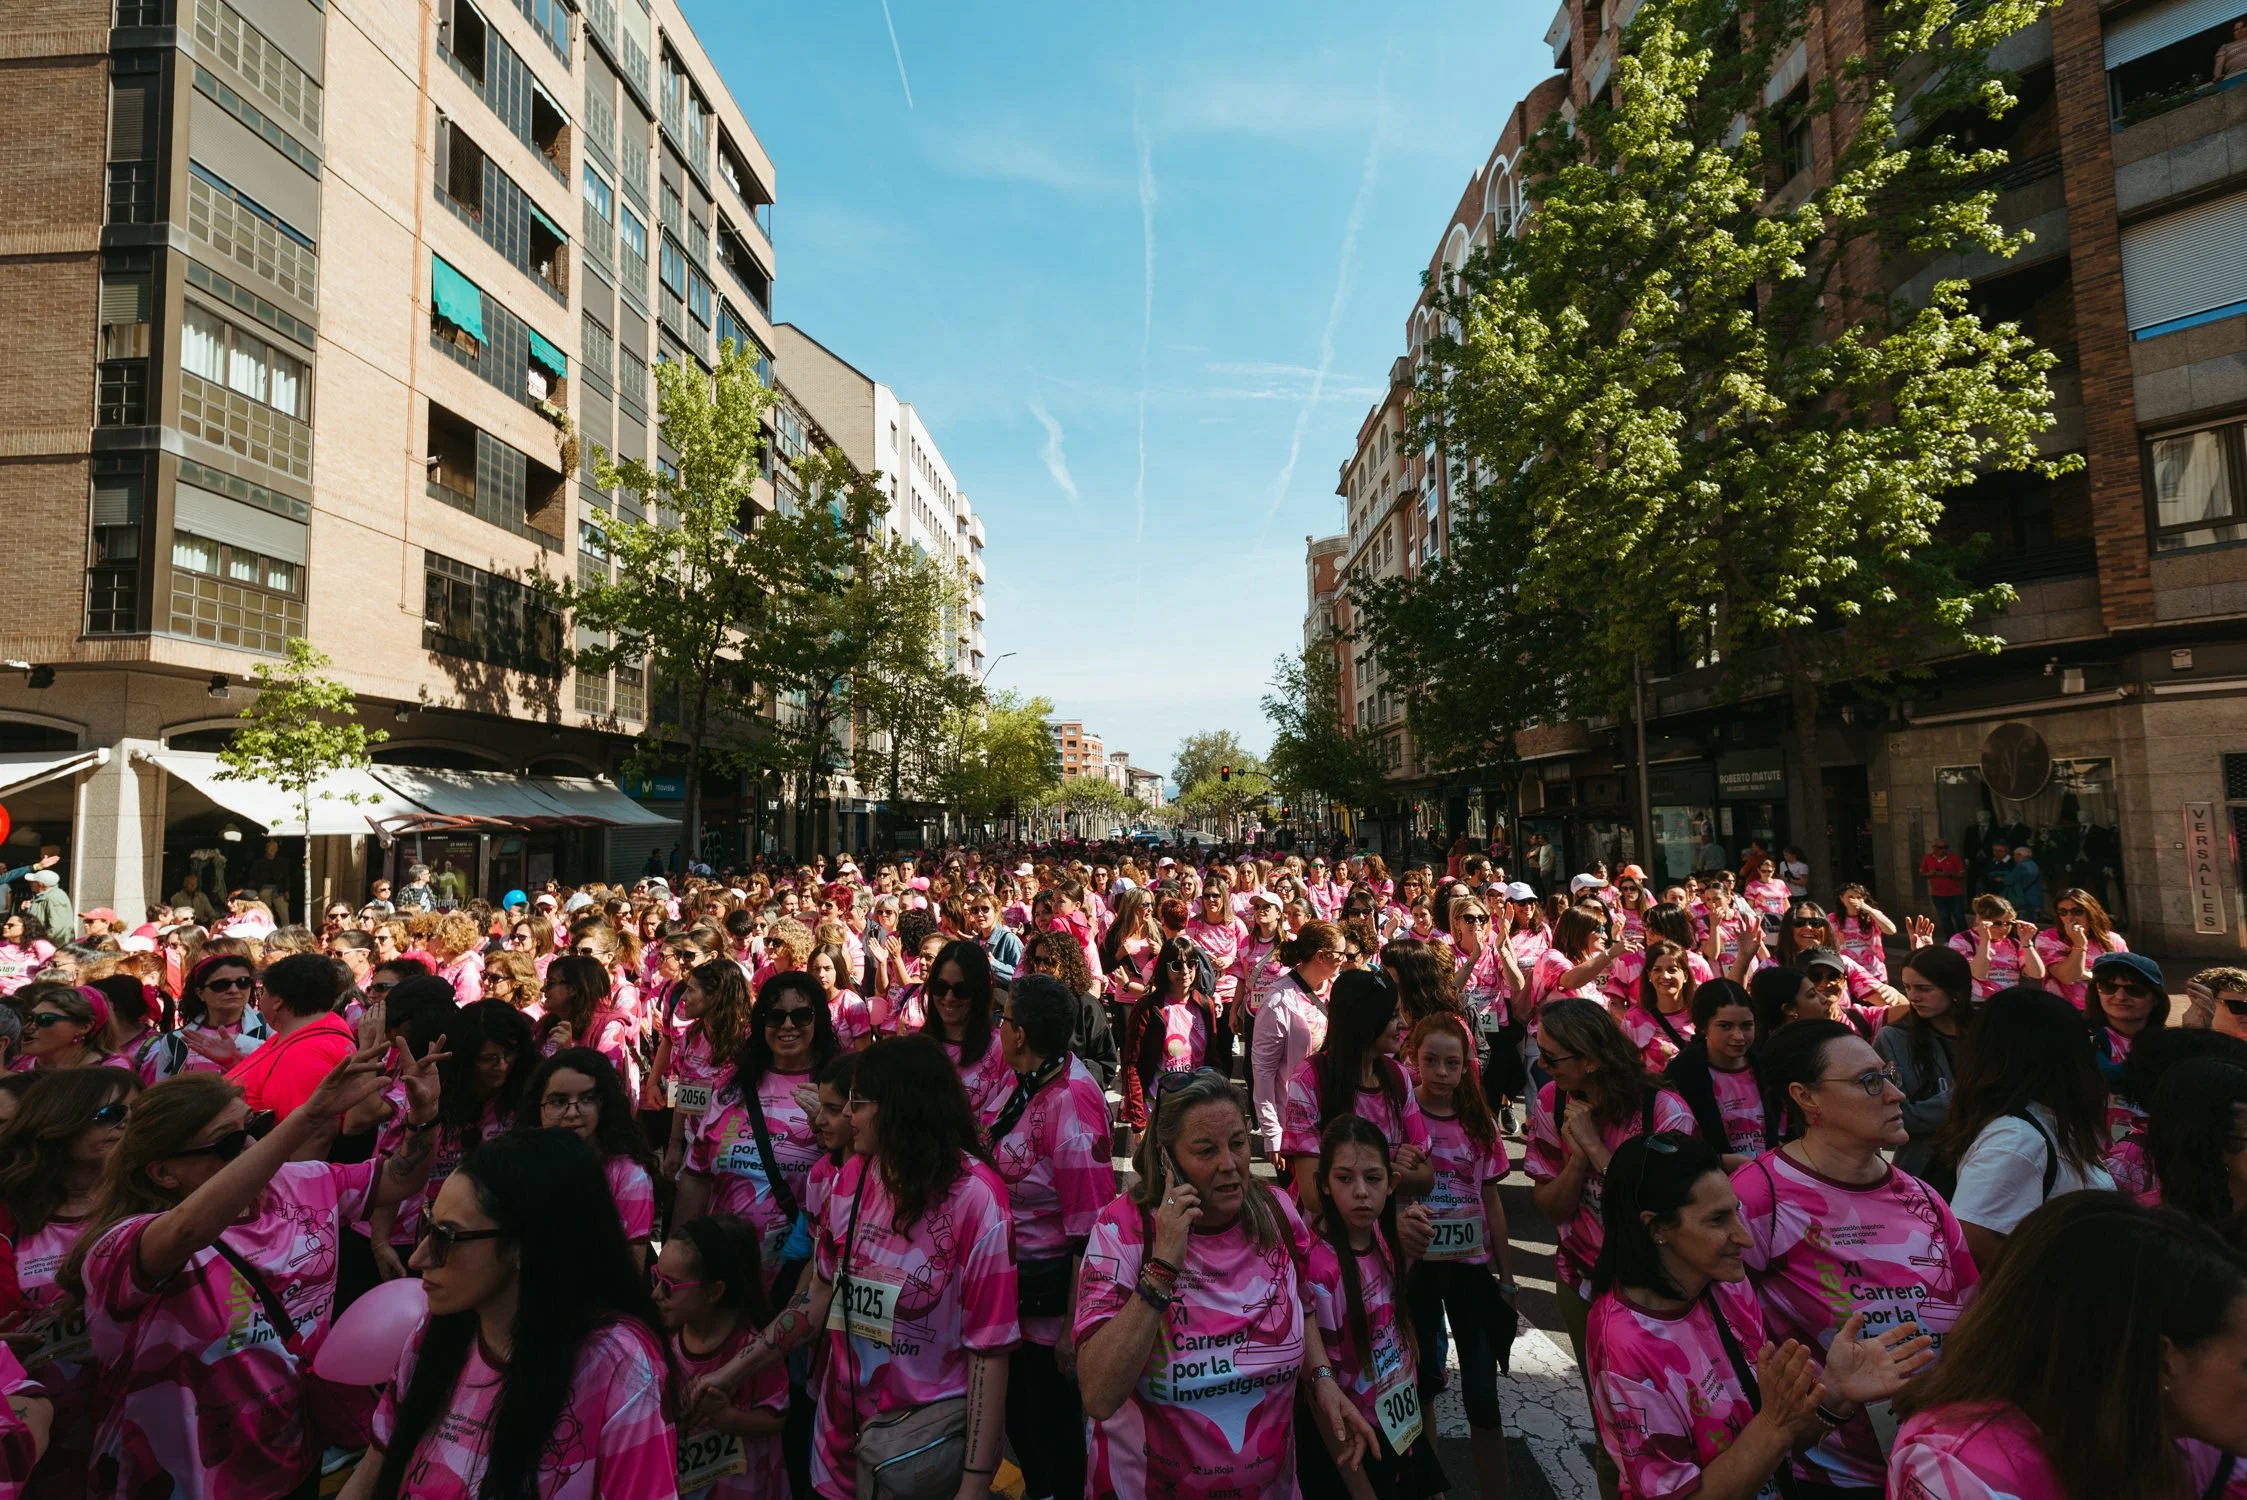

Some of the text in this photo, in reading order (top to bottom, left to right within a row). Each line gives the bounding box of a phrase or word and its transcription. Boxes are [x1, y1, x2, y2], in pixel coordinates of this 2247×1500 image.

[1720, 770, 1781, 784] ROBERTO MATUTE
[2192, 808, 2216, 927] VERSALLES
[681, 1088, 706, 1106] 2056
[731, 1144, 757, 1156] por
[1432, 1222, 1474, 1246] 2750
[1839, 1260, 1863, 1277] XI
[1849, 1283, 1927, 1301] Carrera
[1172, 1305, 1189, 1326] XI
[1863, 1306, 1916, 1325] por la
[1172, 1330, 1246, 1352] Carrera
[1172, 1356, 1232, 1384] por la
[1172, 1365, 1300, 1402] Investigación
[1383, 1382, 1419, 1430] 3087
[677, 1432, 739, 1474] 8292
[407, 1456, 430, 1485] XI
[1203, 1465, 1234, 1476] La Rioja
